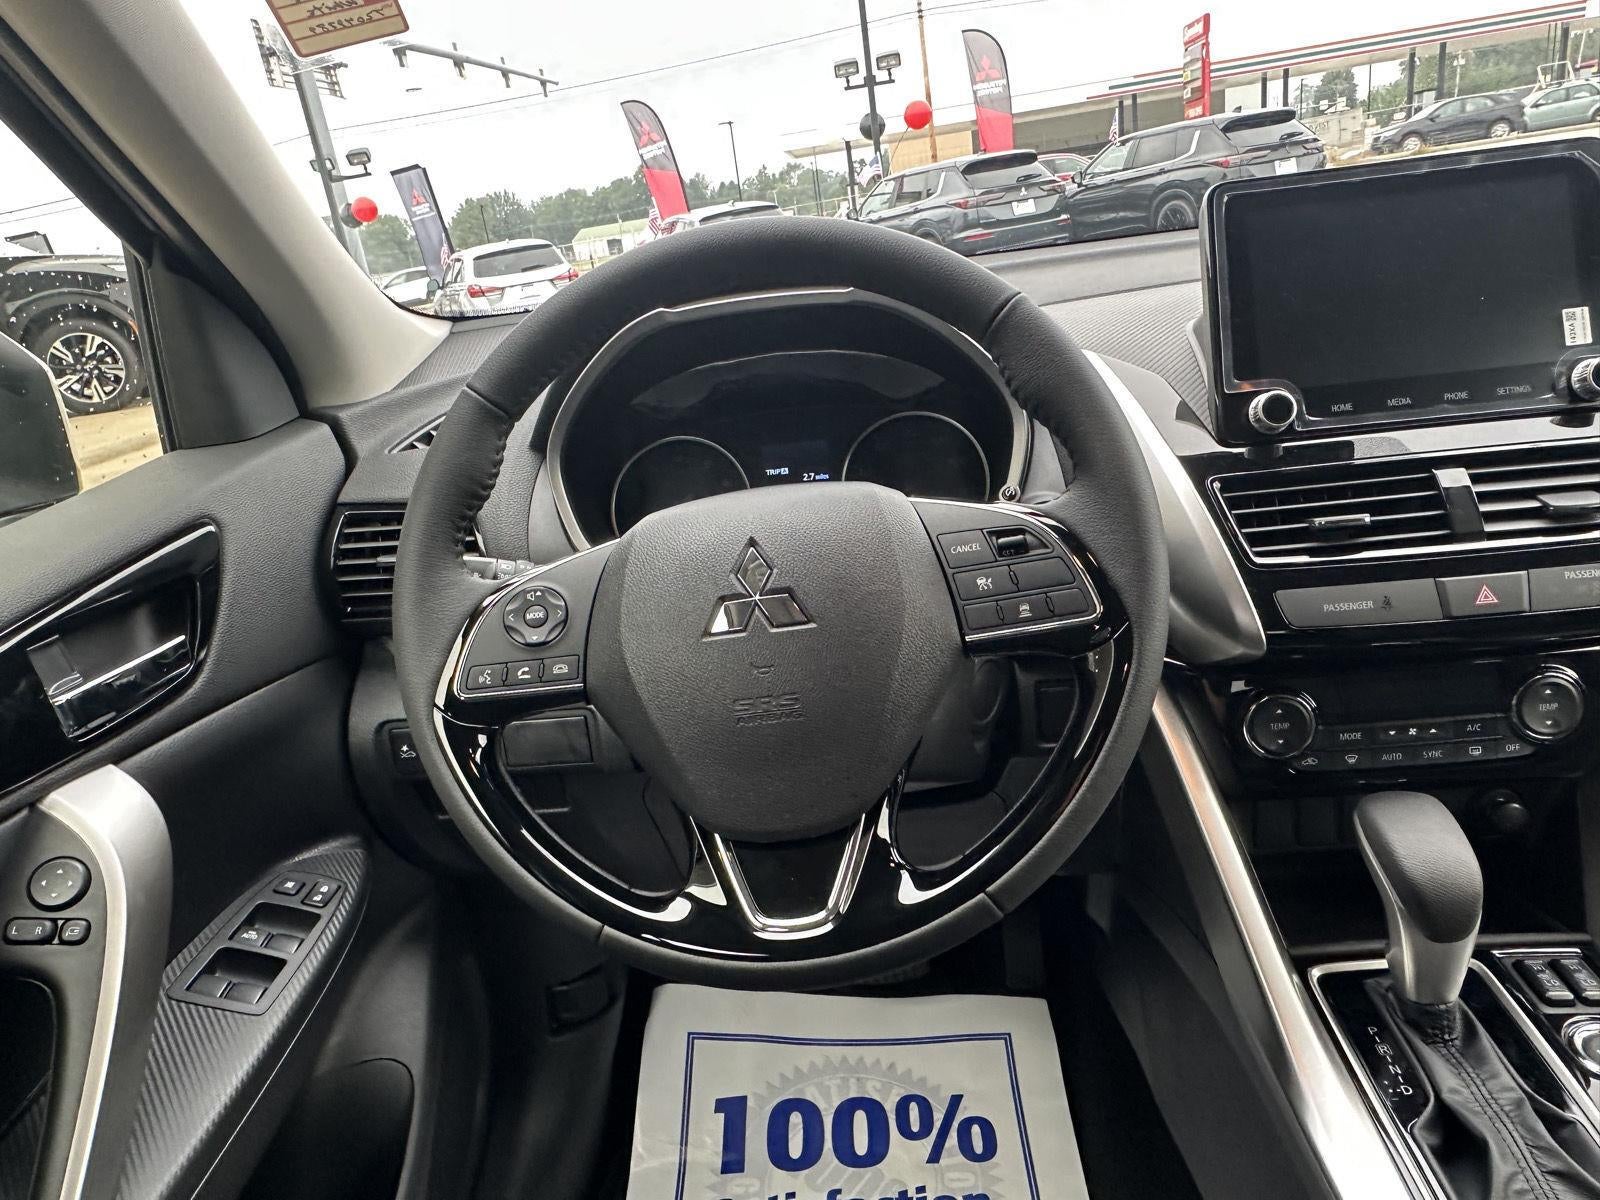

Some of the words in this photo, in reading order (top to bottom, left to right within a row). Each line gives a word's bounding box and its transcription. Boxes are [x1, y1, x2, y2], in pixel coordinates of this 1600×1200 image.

[1496, 384, 1532, 396] SETTINGS
[1444, 391, 1469, 401] PHONE
[1387, 397, 1412, 407] MEDIA
[1331, 403, 1353, 413] HOME
[765, 468, 781, 476] TRIP
[802, 472, 815, 481] 2.7
[950, 542, 982, 554] CANCEL
[1323, 600, 1375, 613] PASSENGER
[526, 612, 545, 620] MODE
[1538, 703, 1559, 712] TEMP
[1270, 722, 1290, 730] TEMP
[1466, 723, 1482, 732] A/C
[1339, 732, 1363, 741] MODE
[1505, 744, 1521, 753] OFF
[1381, 752, 1403, 762] AUTO
[1423, 750, 1443, 759] SYNC
[11, 926, 18, 935] L
[34, 926, 42, 935] R
[1400, 1085, 1413, 1095] D
[713, 1093, 998, 1175] 100%
